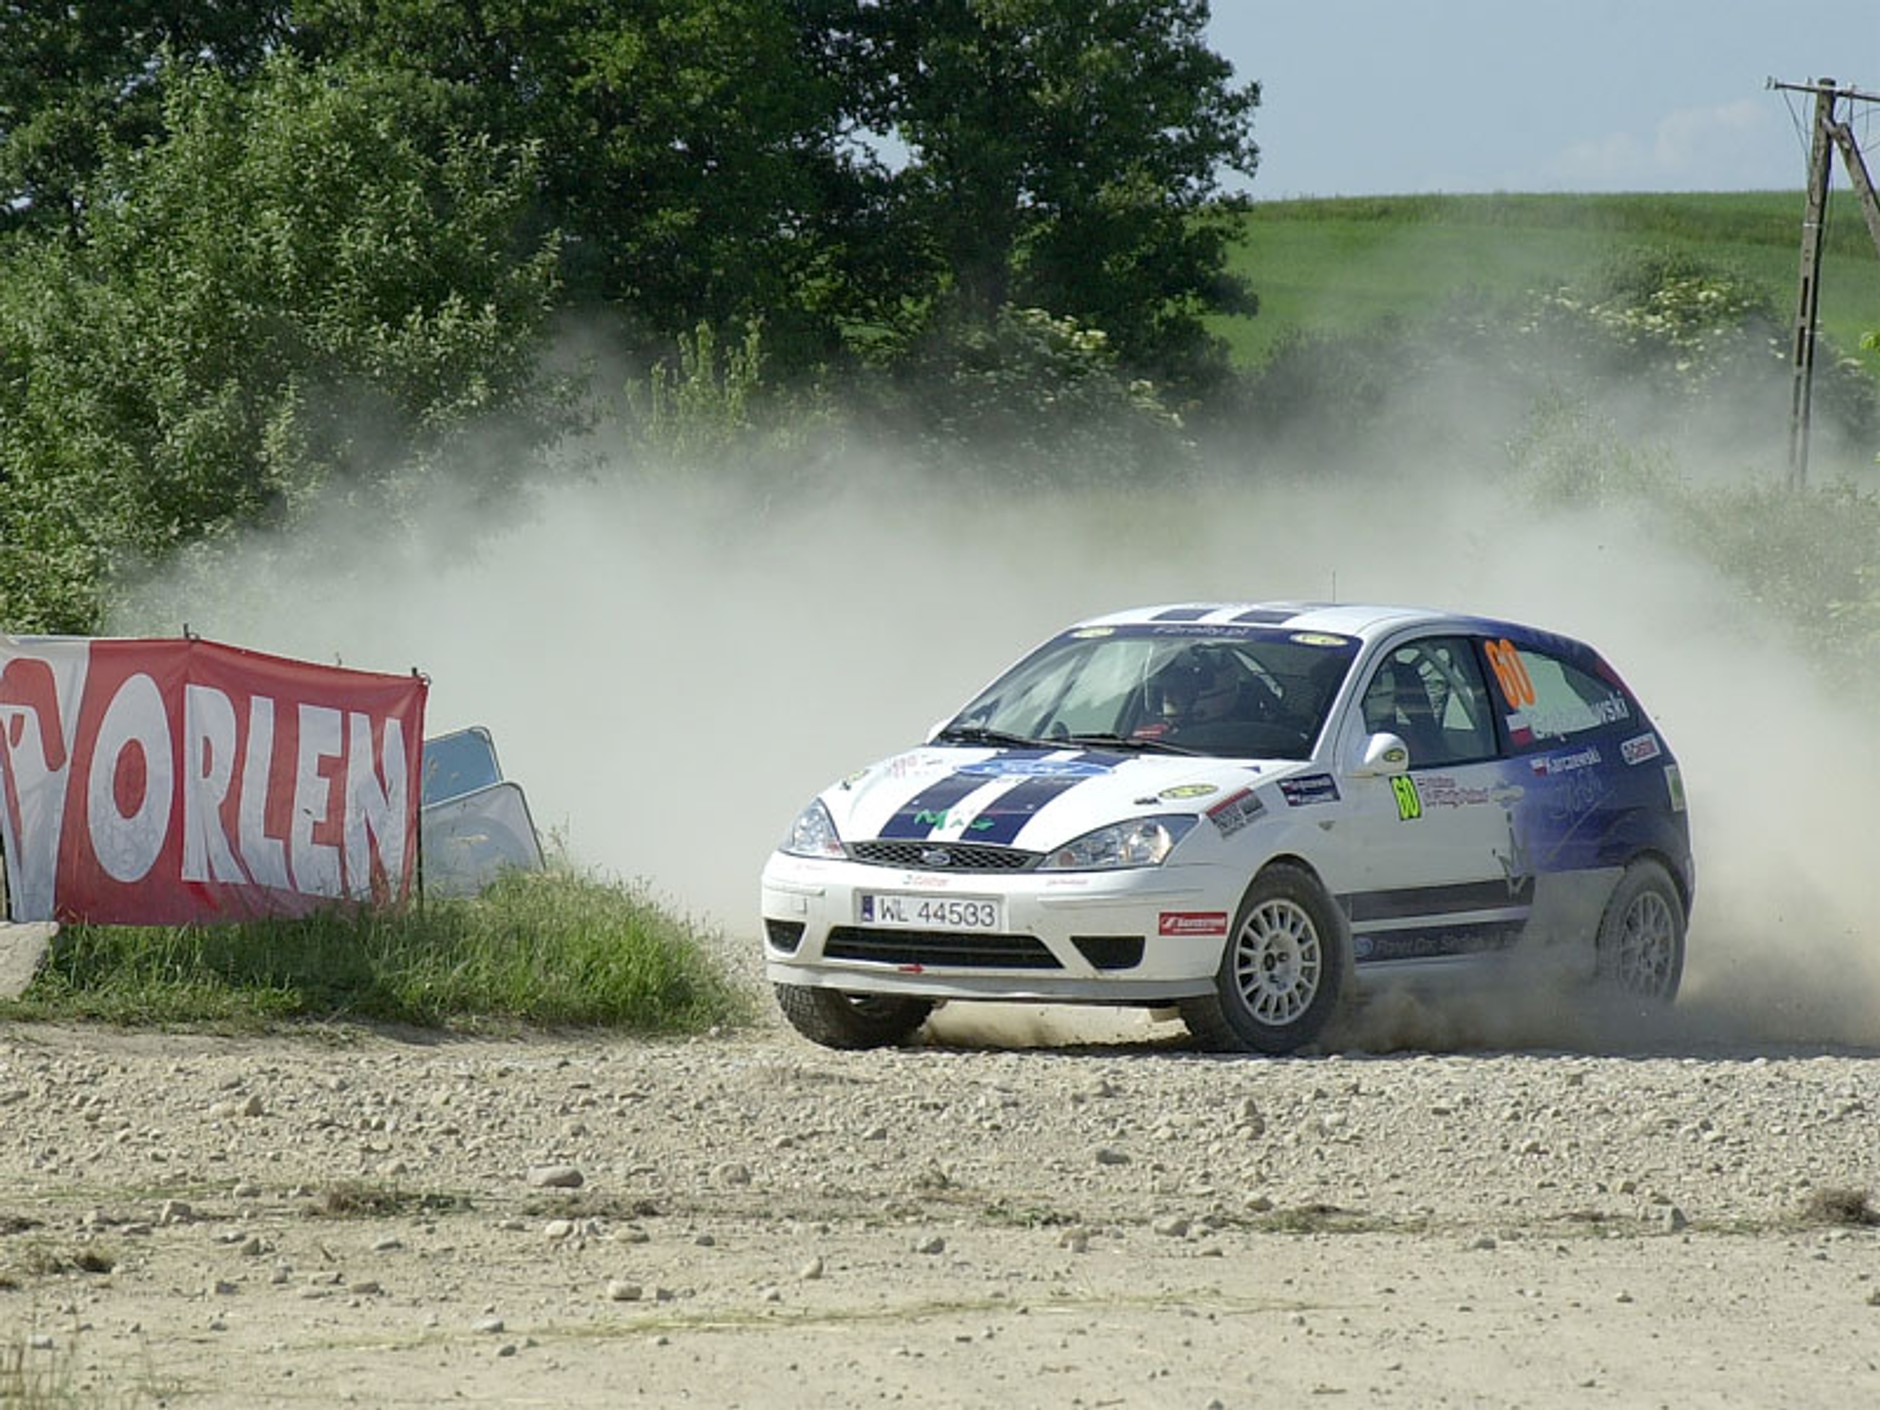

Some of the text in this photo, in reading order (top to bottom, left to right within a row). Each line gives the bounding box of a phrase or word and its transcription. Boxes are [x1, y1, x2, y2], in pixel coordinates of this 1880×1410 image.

[1484, 638, 1536, 710] 60
[87, 672, 410, 901] ORLEN
[1391, 775, 1420, 819] 60
[881, 898, 995, 927] WL 44533
